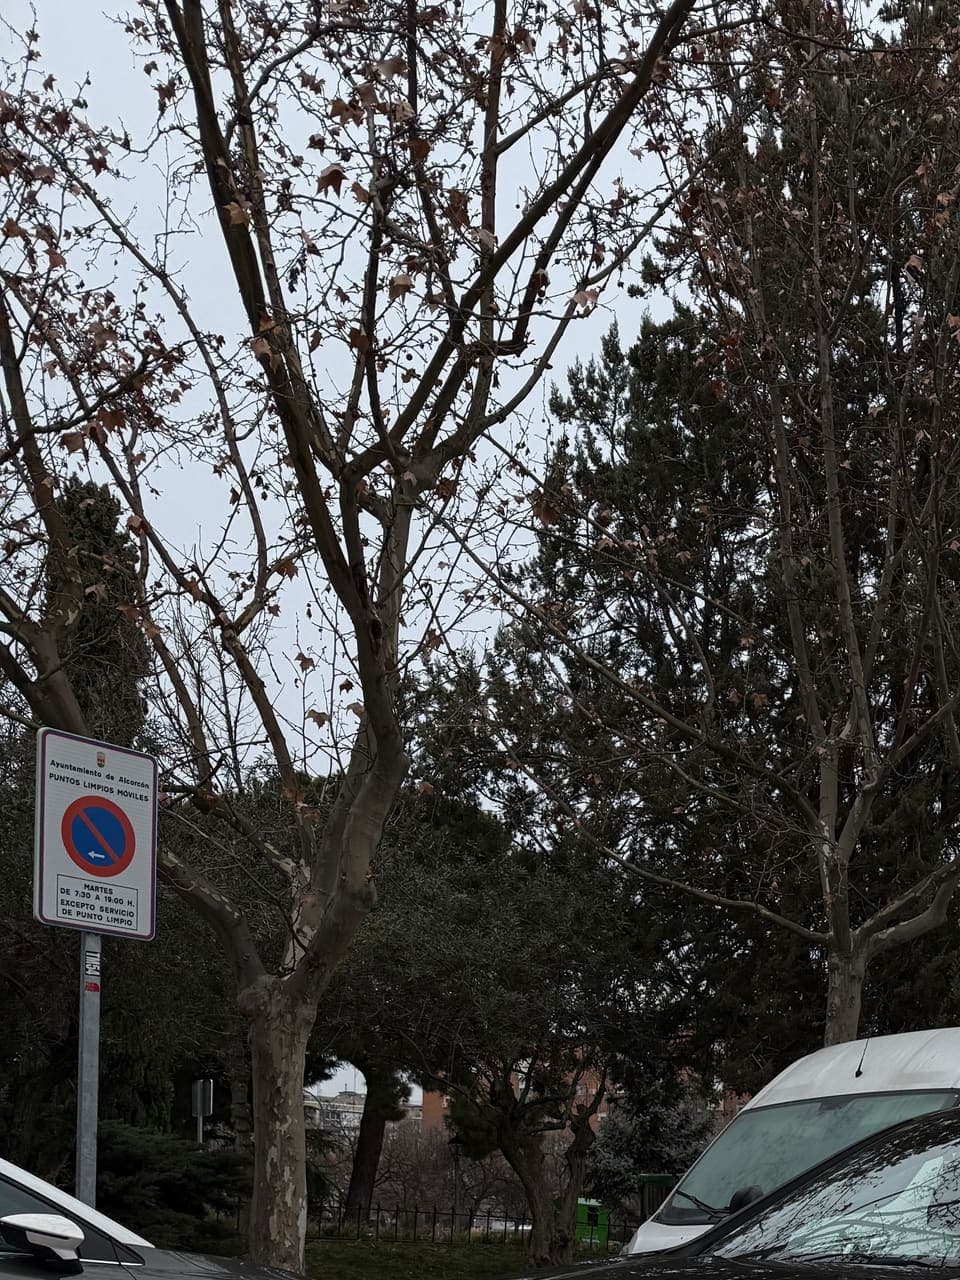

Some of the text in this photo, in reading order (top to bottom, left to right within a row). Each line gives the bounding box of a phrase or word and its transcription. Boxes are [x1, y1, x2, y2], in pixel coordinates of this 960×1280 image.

[49, 772, 80, 786] PUNTOS
[83, 781, 114, 794] LIMPIOS
[50, 760, 150, 789] Ayuntamiento de Alcorcón
[60, 887, 71, 896] DE
[83, 883, 113, 895] MARTES
[60, 899, 135, 918] EXCEPTO SERVICIO
[62, 908, 133, 926] DE PUNTO LIMPIO
